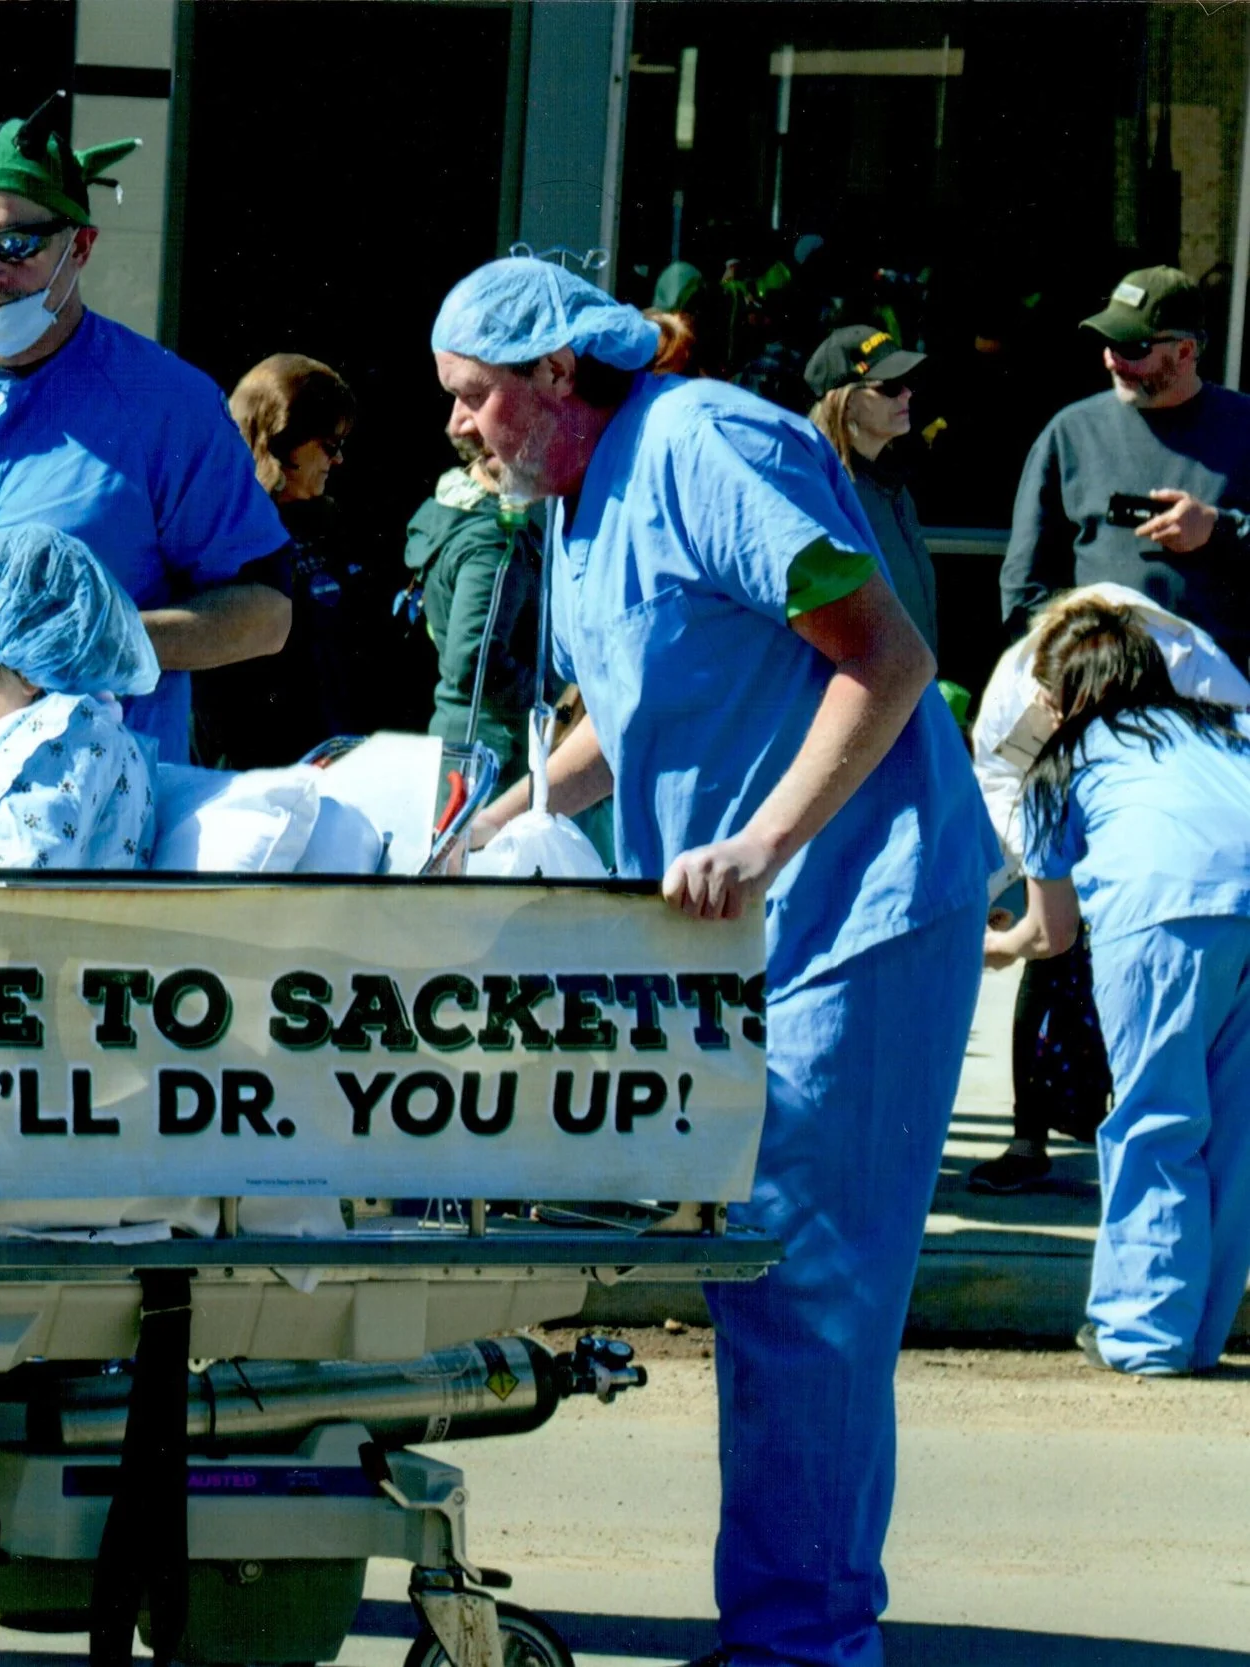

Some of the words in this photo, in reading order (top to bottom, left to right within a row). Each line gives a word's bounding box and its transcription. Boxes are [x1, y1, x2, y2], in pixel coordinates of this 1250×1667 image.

[82, 967, 233, 1050] TO
[157, 1068, 296, 1138] DR.
[336, 1070, 519, 1137] YOU
[552, 1070, 693, 1134] UP!
